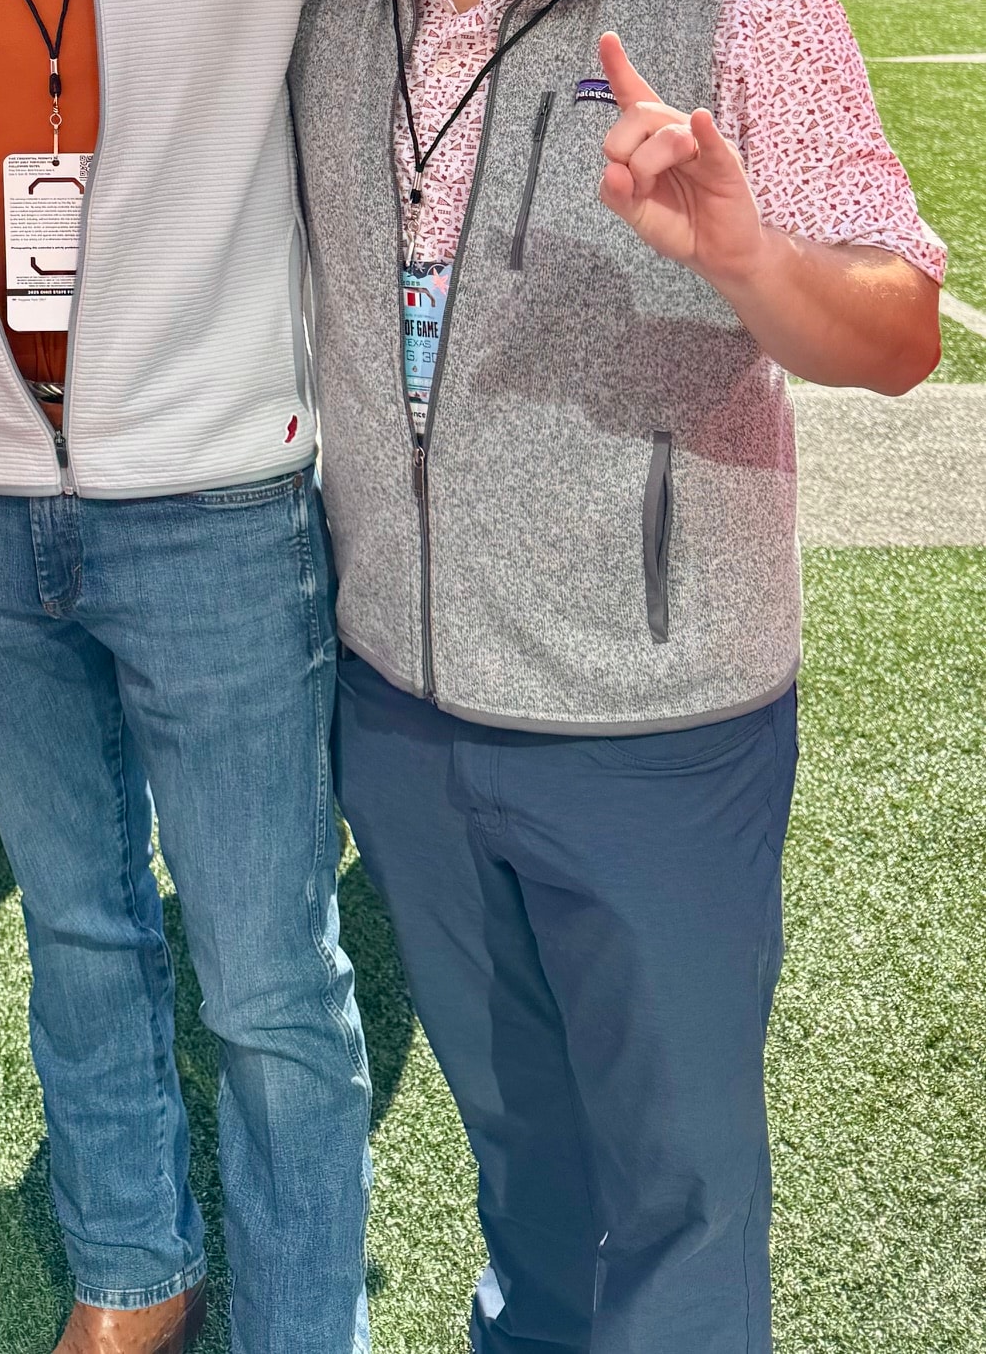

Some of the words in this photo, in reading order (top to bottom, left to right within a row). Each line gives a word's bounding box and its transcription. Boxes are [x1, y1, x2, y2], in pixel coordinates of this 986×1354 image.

[575, 90, 617, 100] patagon
[405, 320, 414, 336] OF
[416, 320, 439, 338] GAME
